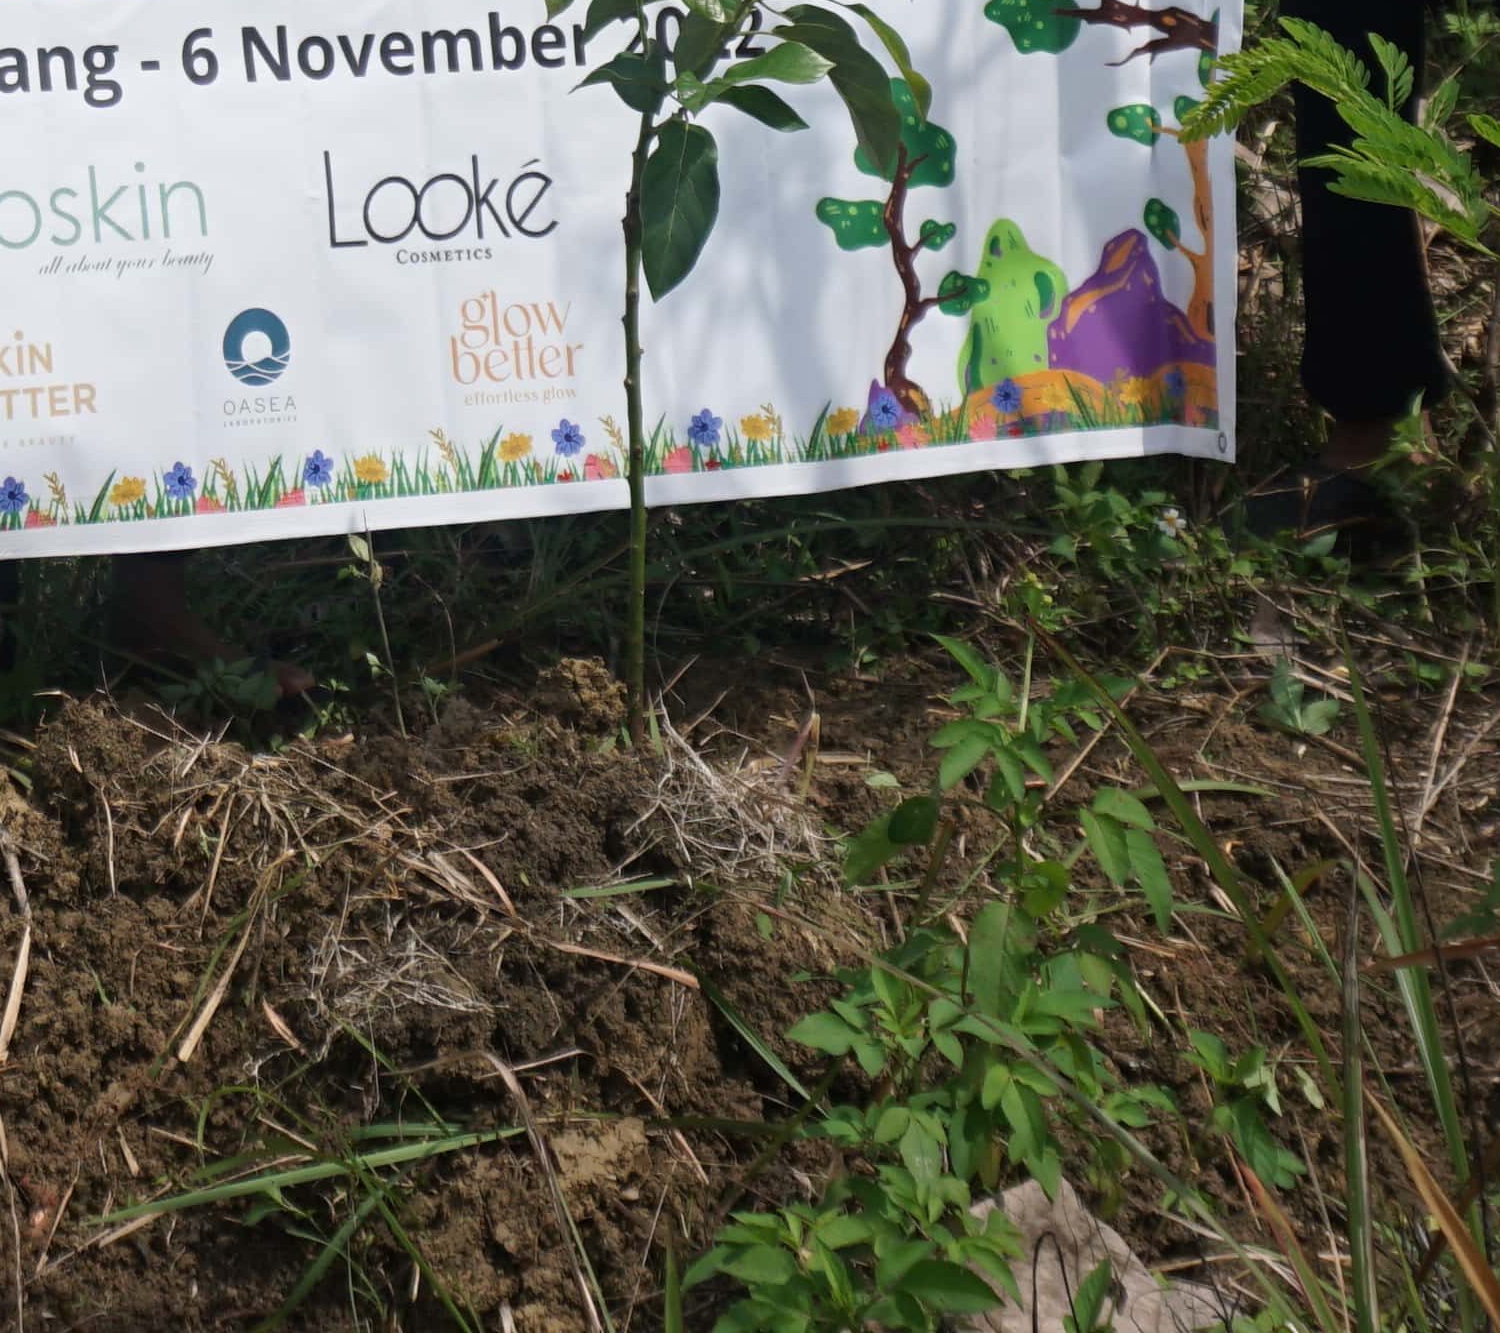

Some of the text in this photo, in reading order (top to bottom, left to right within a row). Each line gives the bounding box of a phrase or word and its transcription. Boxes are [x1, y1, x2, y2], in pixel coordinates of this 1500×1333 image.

[181, 28, 219, 85] 6
[242, 12, 590, 83] November
[461, 290, 571, 349] glow
[451, 335, 584, 384] better
[223, 395, 297, 416] OASEA
